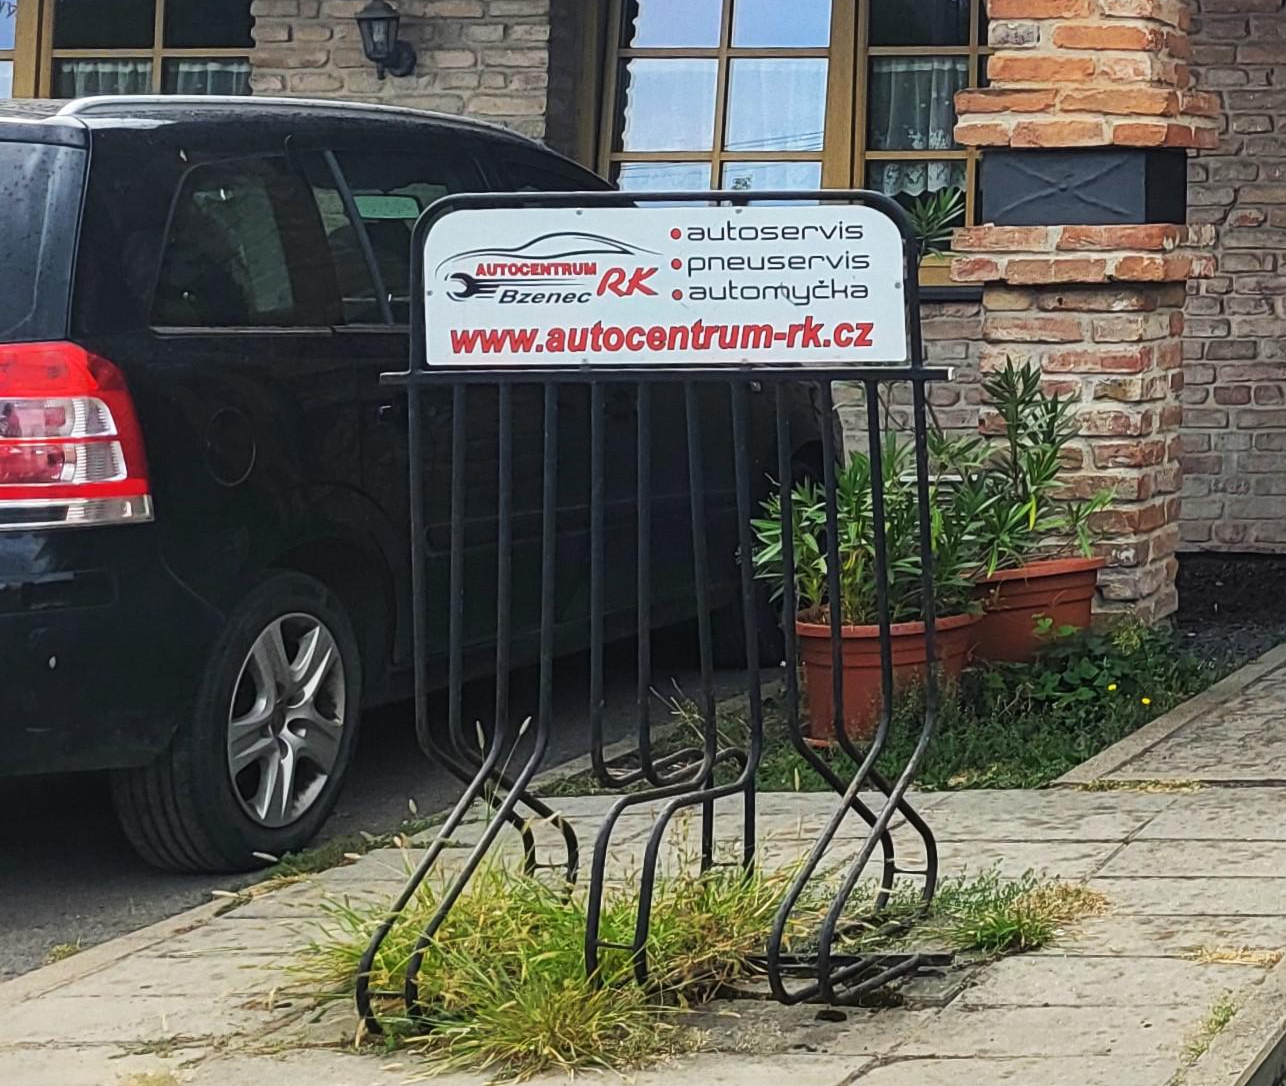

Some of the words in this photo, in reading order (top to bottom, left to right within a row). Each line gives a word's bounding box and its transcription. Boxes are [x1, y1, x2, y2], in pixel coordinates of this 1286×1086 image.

[687, 220, 864, 241] autoservis
[475, 262, 597, 277] AUTOCENTRUM
[687, 250, 871, 277] pneuservis
[596, 267, 659, 298] RK
[689, 278, 869, 306] automyčka
[498, 289, 593, 305] Bzenec
[450, 315, 875, 354] www.autocentrum-rk.cz
